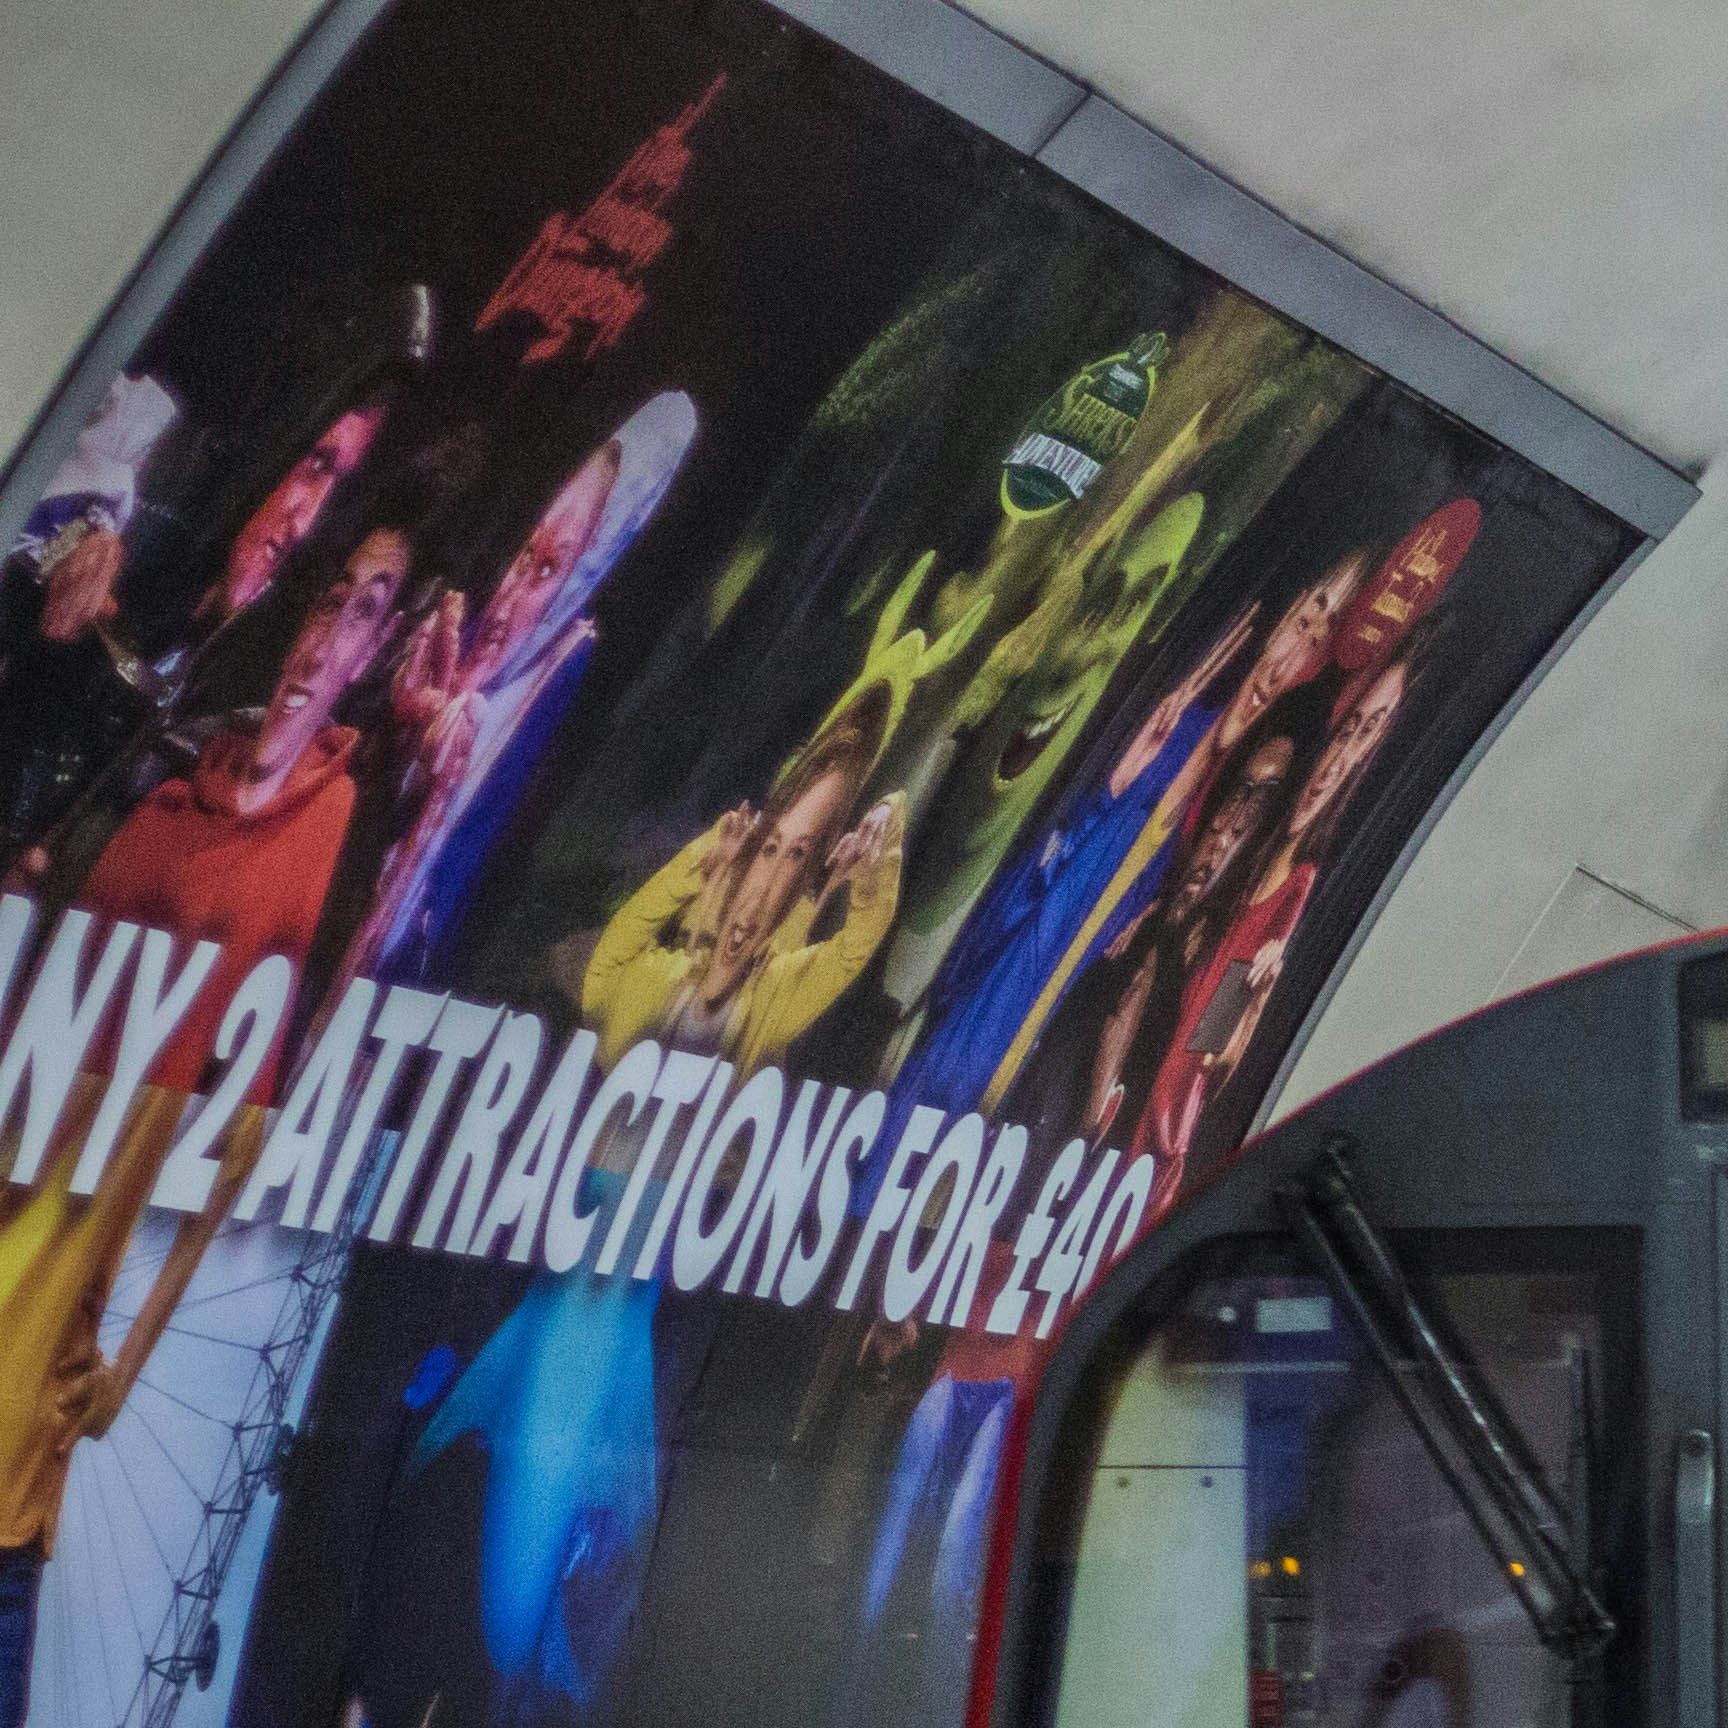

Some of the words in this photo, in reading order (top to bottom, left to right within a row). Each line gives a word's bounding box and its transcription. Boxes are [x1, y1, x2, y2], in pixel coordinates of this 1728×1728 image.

[149, 953, 294, 1213] 2
[232, 976, 887, 1307] ATTRACTIONS
[836, 1104, 1029, 1326] FOR
